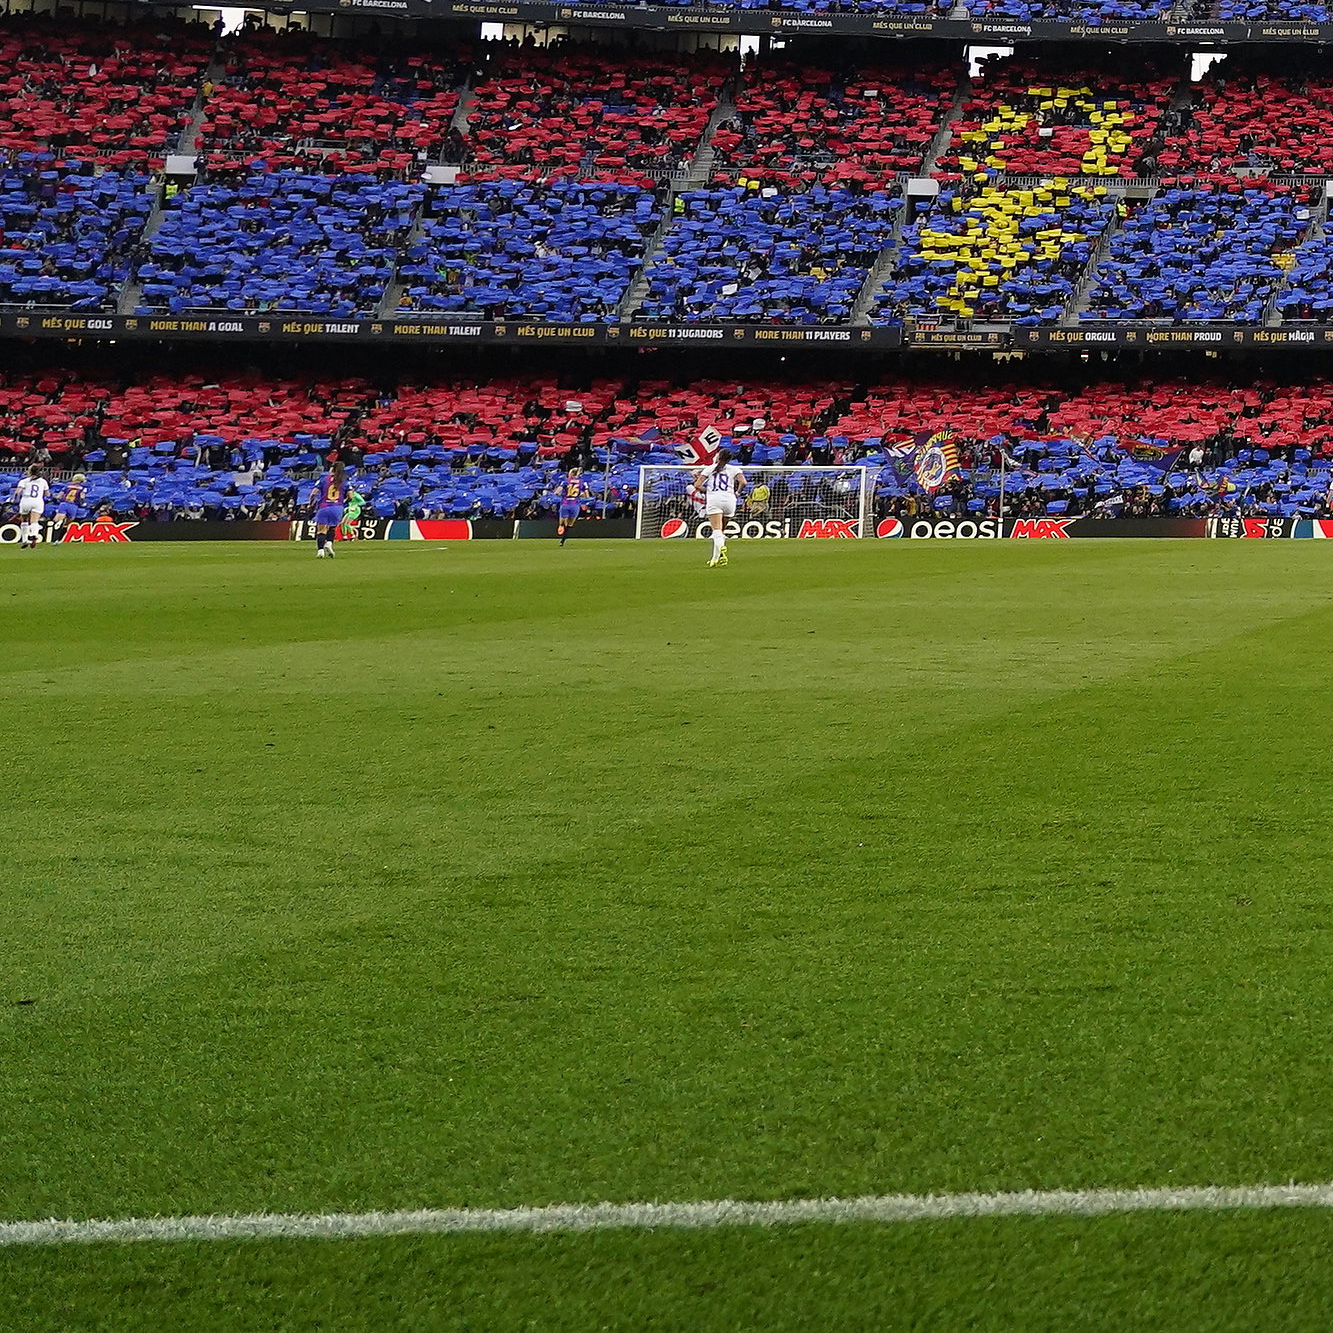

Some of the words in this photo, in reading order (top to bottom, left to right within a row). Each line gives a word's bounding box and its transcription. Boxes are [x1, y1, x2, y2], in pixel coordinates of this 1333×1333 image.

[582, 10, 625, 19] BARCELONA
[42, 318, 62, 328] MÉS
[64, 320, 85, 330] QUE
[87, 320, 112, 329] GOLS
[150, 322, 178, 331] MORE
[180, 322, 206, 331] THAN
[208, 322, 216, 331] A
[218, 323, 244, 331] GOAL
[282, 323, 302, 333] MÉS
[304, 325, 324, 335] QUE
[326, 325, 360, 334] TALENT
[394, 325, 420, 334] MORE
[423, 326, 447, 335] THAN
[449, 326, 481, 335] TALENT
[518, 325, 536, 336] MÉS
[538, 327, 556, 338] QUE
[558, 328, 570, 336] UN
[572, 328, 595, 336] CLUB
[630, 328, 647, 338] MÉS
[649, 330, 667, 340] QUE
[668, 330, 676, 338] 11
[678, 330, 723, 339] JUGADORS
[755, 331, 779, 340] MORE
[782, 331, 804, 340] THAN
[806, 331, 813, 340] 11
[814, 331, 850, 340] PLAYERS
[1050, 331, 1066, 341] MÉS
[1067, 333, 1084, 343] QUE
[1085, 333, 1116, 341] ORGULL
[1146, 333, 1169, 341] MORE
[1170, 333, 1193, 341] THAN
[1194, 333, 1222, 341] PROUD
[1254, 330, 1269, 341] MÉS
[1270, 332, 1287, 342] QUE
[712, 473, 729, 491] 18
[62, 522, 140, 542] MAX
[797, 519, 860, 539] MAX
[911, 518, 1004, 539] pepsi
[1010, 519, 1077, 539] MAX
